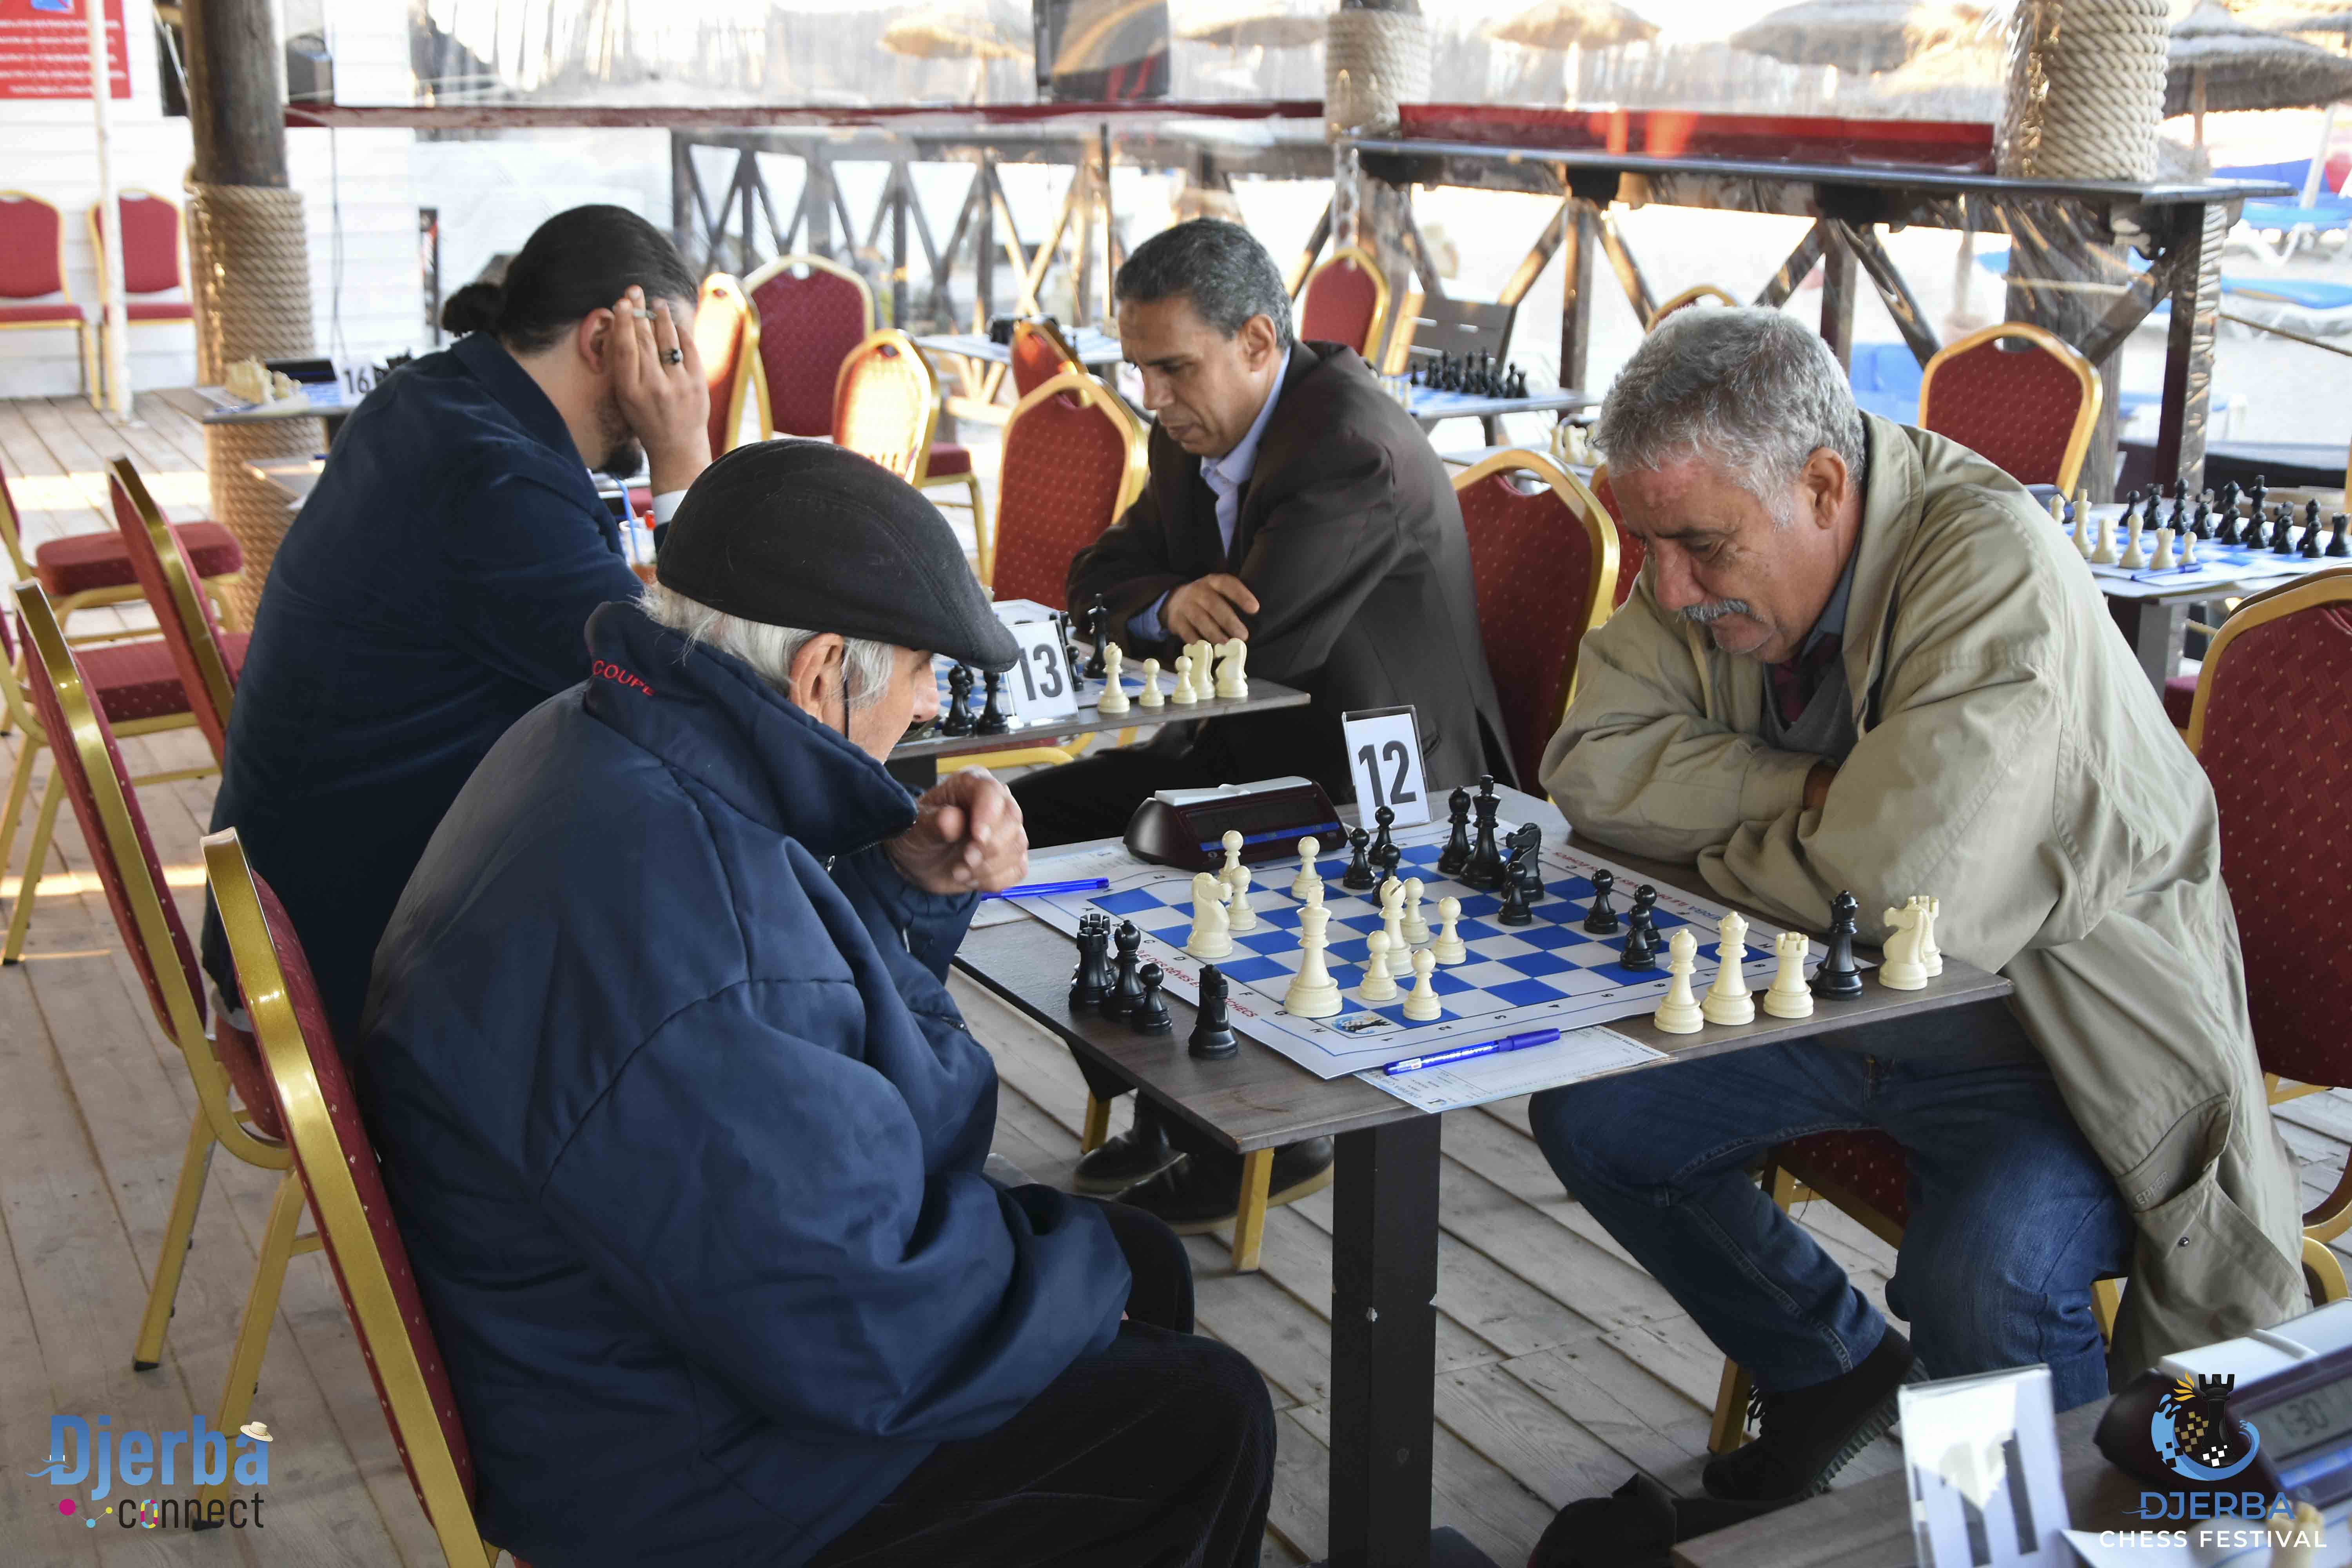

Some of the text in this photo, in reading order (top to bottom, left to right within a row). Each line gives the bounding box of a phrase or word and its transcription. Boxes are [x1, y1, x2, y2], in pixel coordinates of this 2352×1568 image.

[344, 364, 370, 394] 16
[1018, 643, 1063, 701] 13
[1358, 739, 1417, 807] 12
[2135, 1171, 2168, 1205] EPPER
